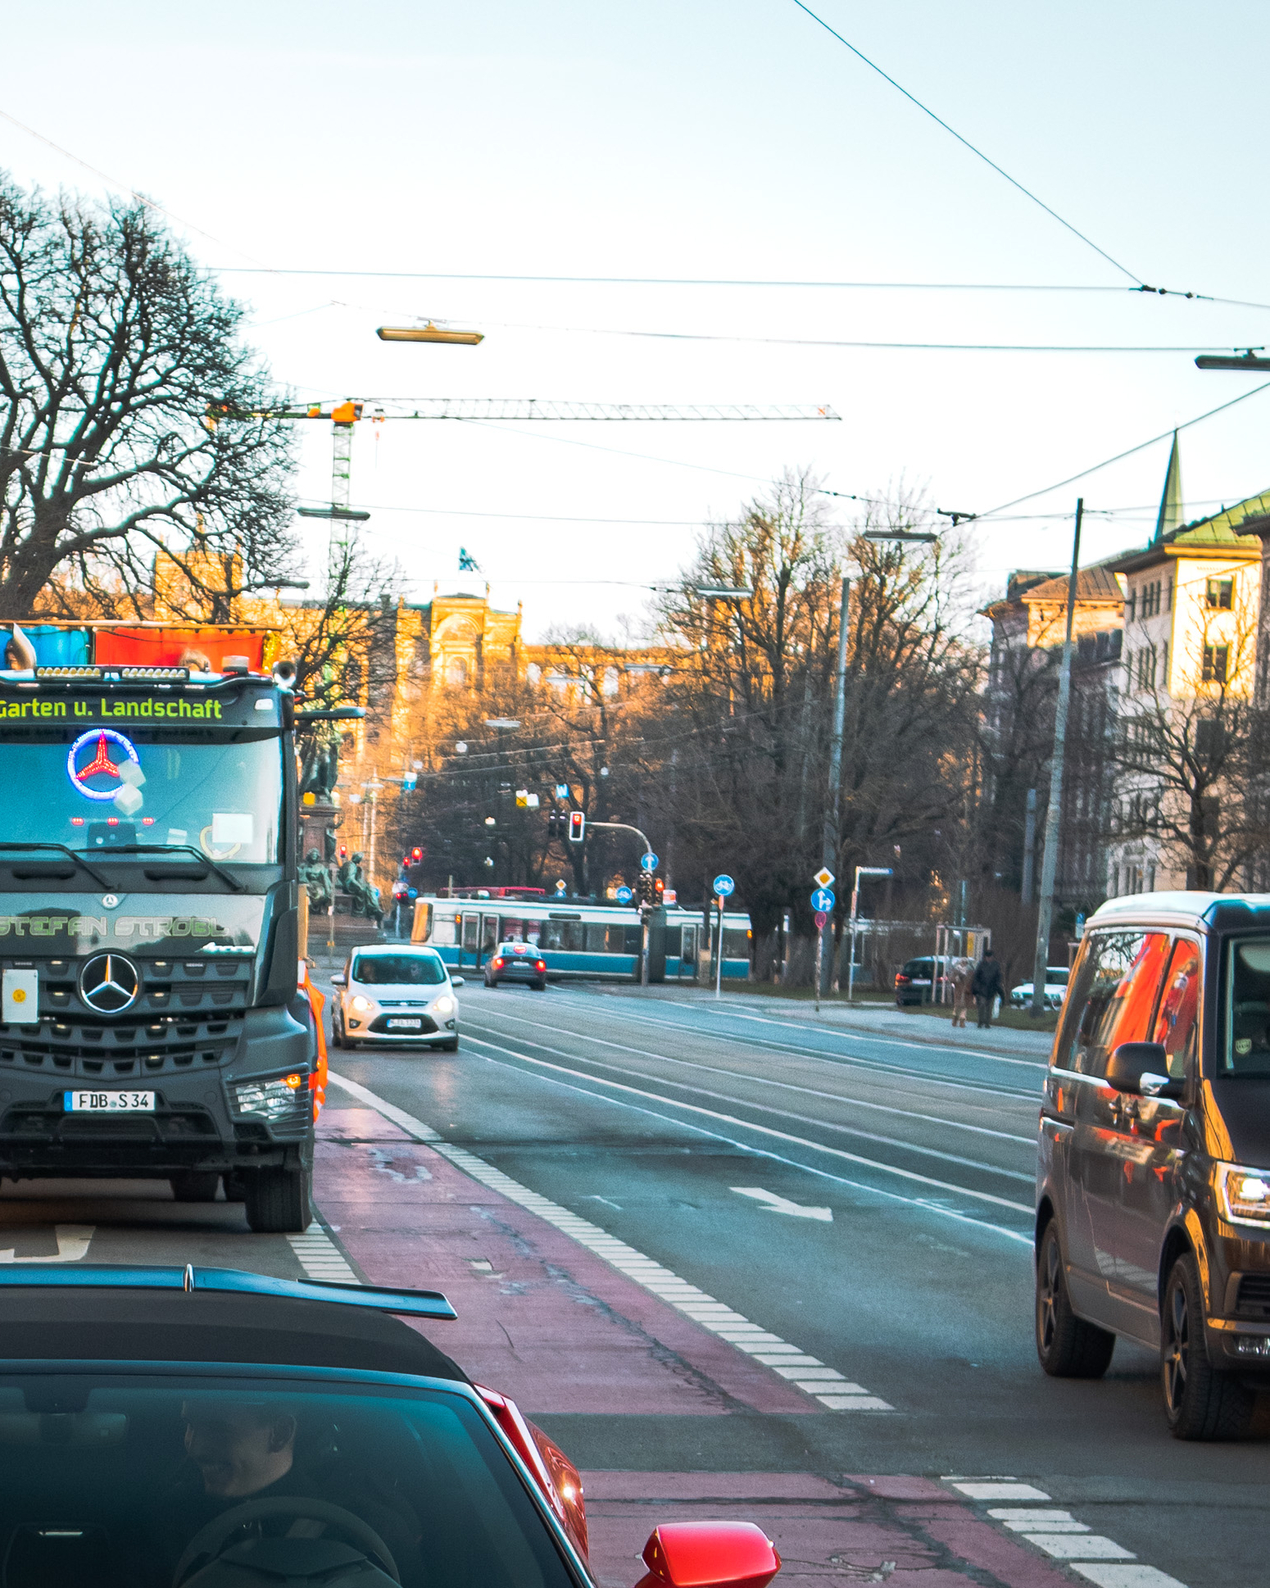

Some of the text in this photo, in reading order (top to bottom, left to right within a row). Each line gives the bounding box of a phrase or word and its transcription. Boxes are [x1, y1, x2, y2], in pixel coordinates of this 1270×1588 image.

[74, 701, 93, 716] u.
[101, 698, 223, 719] Landschaft
[114, 915, 230, 937] STROBL
[79, 1093, 149, 1109] FDB S 34
